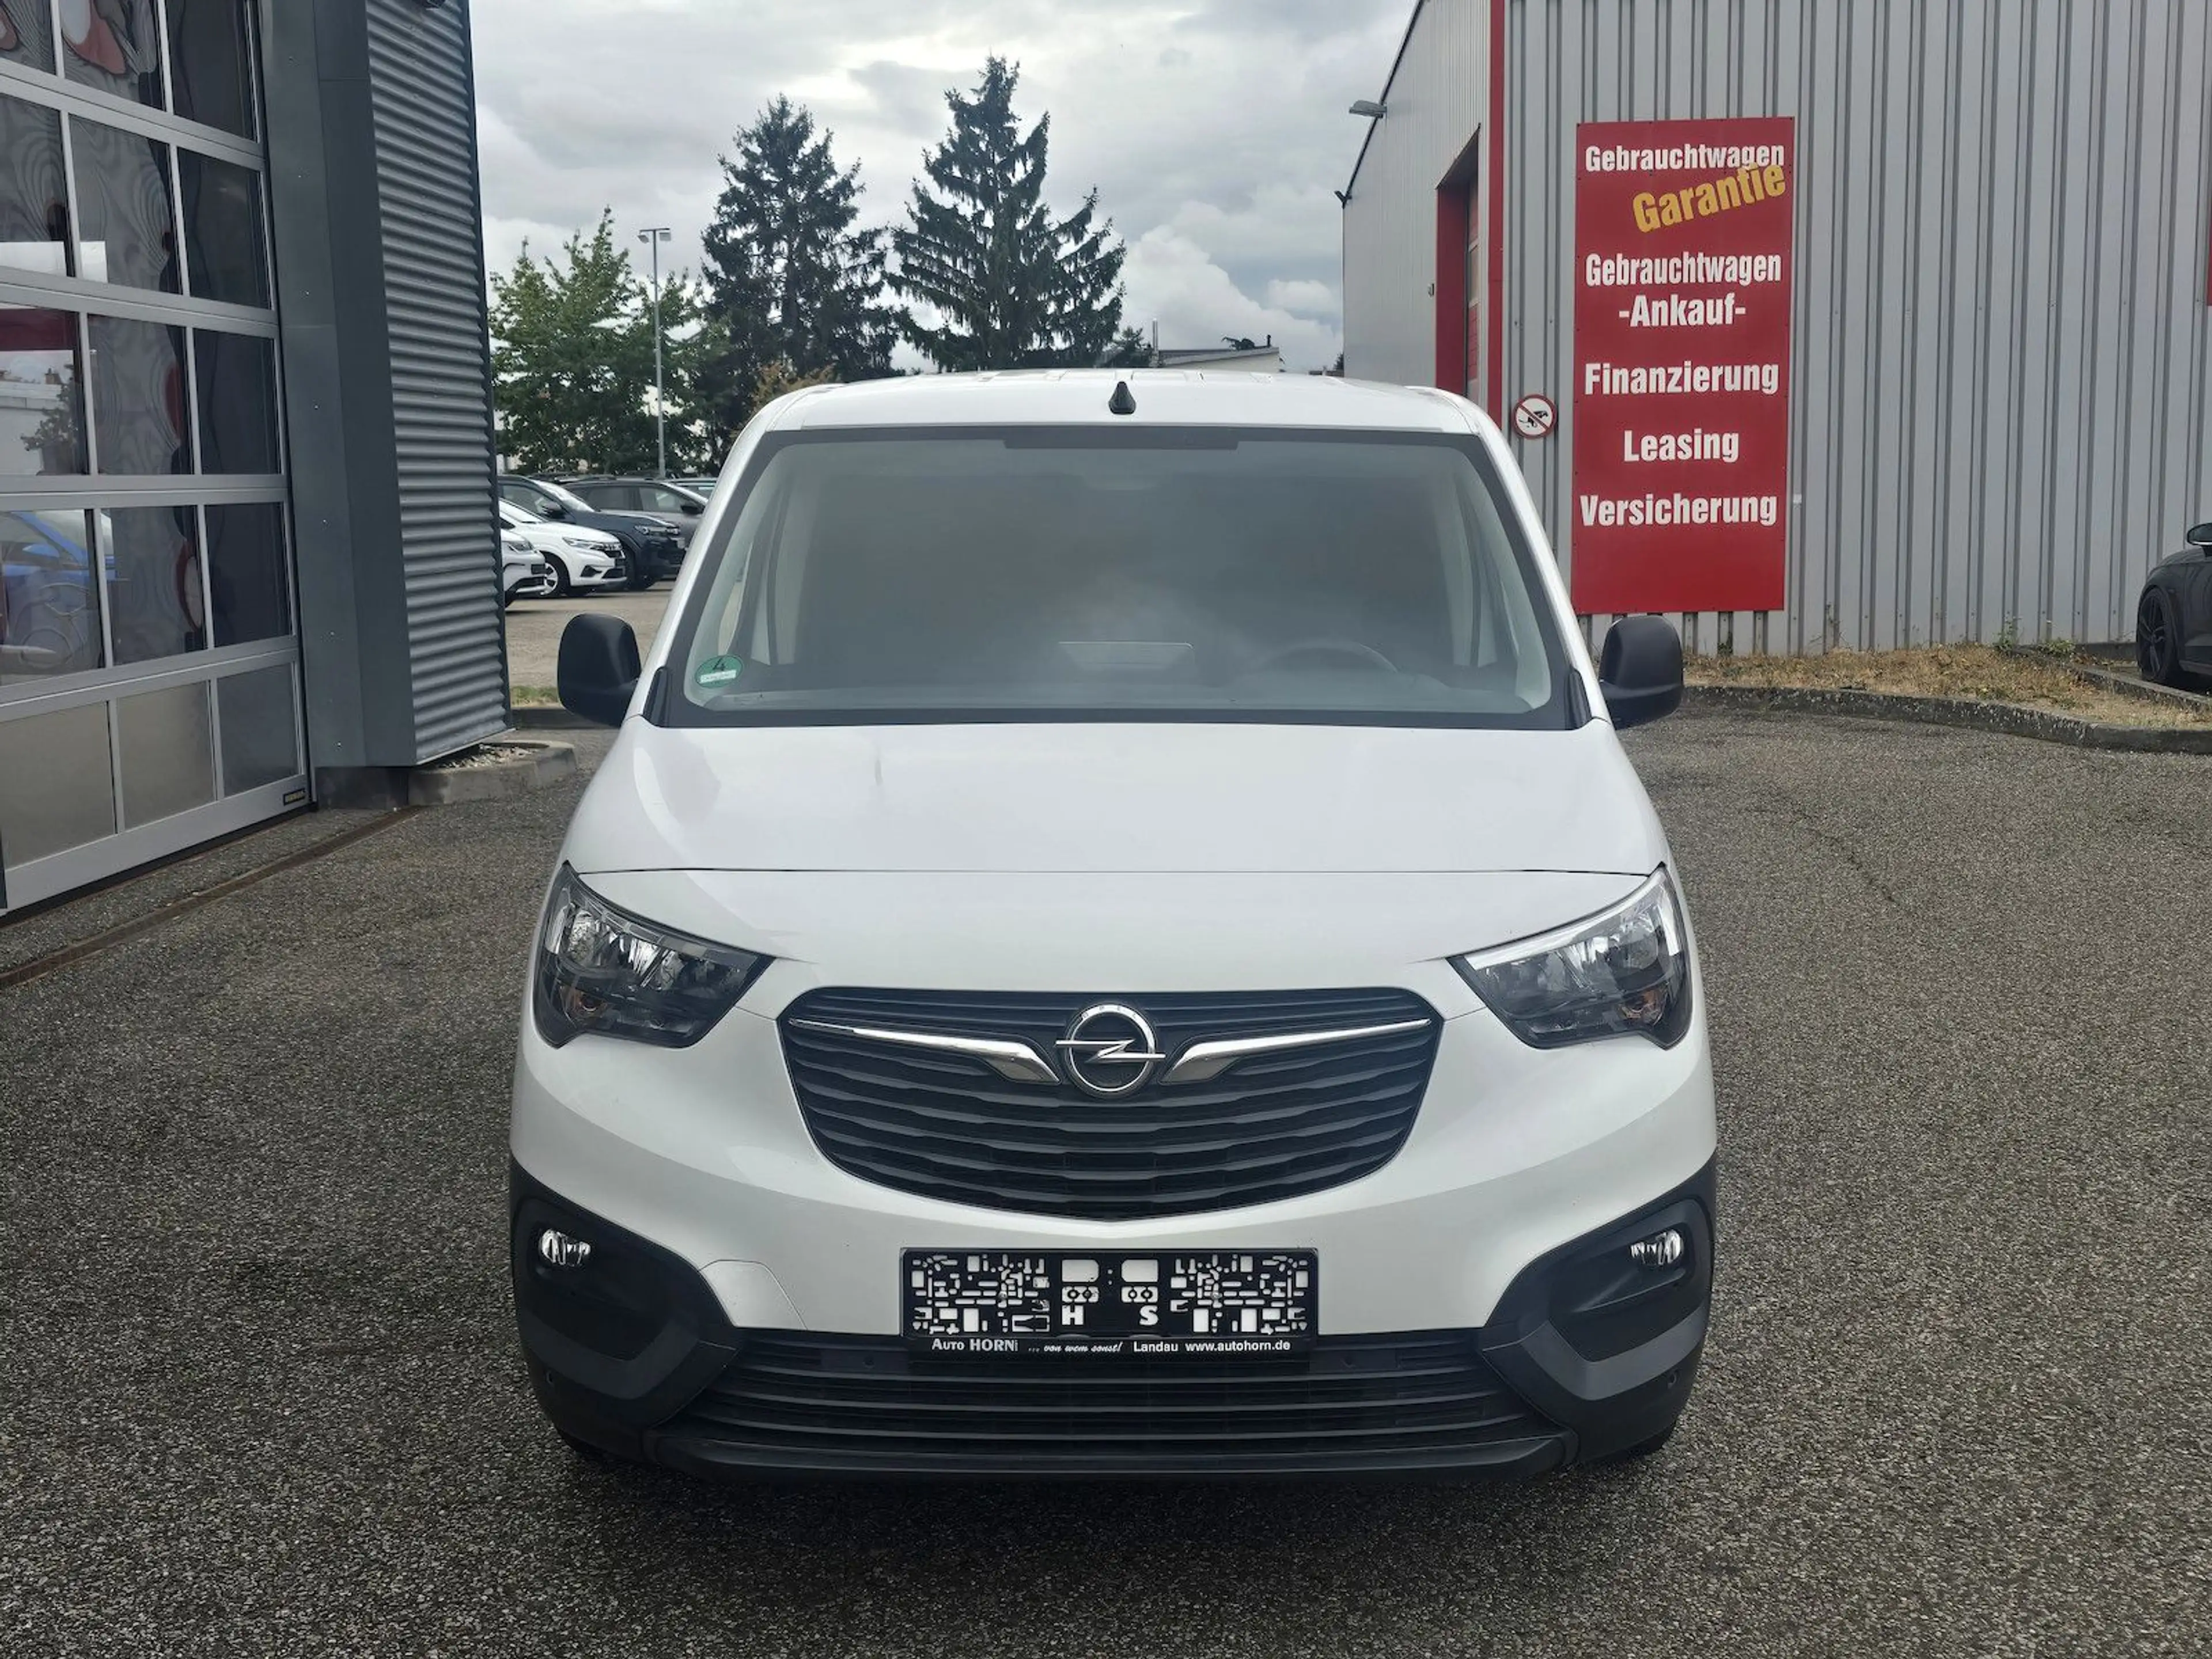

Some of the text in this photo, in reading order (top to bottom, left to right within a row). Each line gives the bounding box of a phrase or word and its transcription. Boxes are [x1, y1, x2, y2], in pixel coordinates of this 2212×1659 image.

[1585, 143, 1785, 171] Gebrauchtwagen
[1633, 163, 1785, 233] Garantie
[1586, 251, 1782, 286] Gebrauchtwagen
[1619, 292, 1746, 327] -Ankauf-
[1585, 360, 1779, 395] Finanzierung
[1624, 428, 1739, 463] Leasing
[1580, 493, 1777, 527] Versicherung
[1133, 1340, 1179, 1353] Landau
[1184, 1339, 1291, 1352] www.autohorn.de
